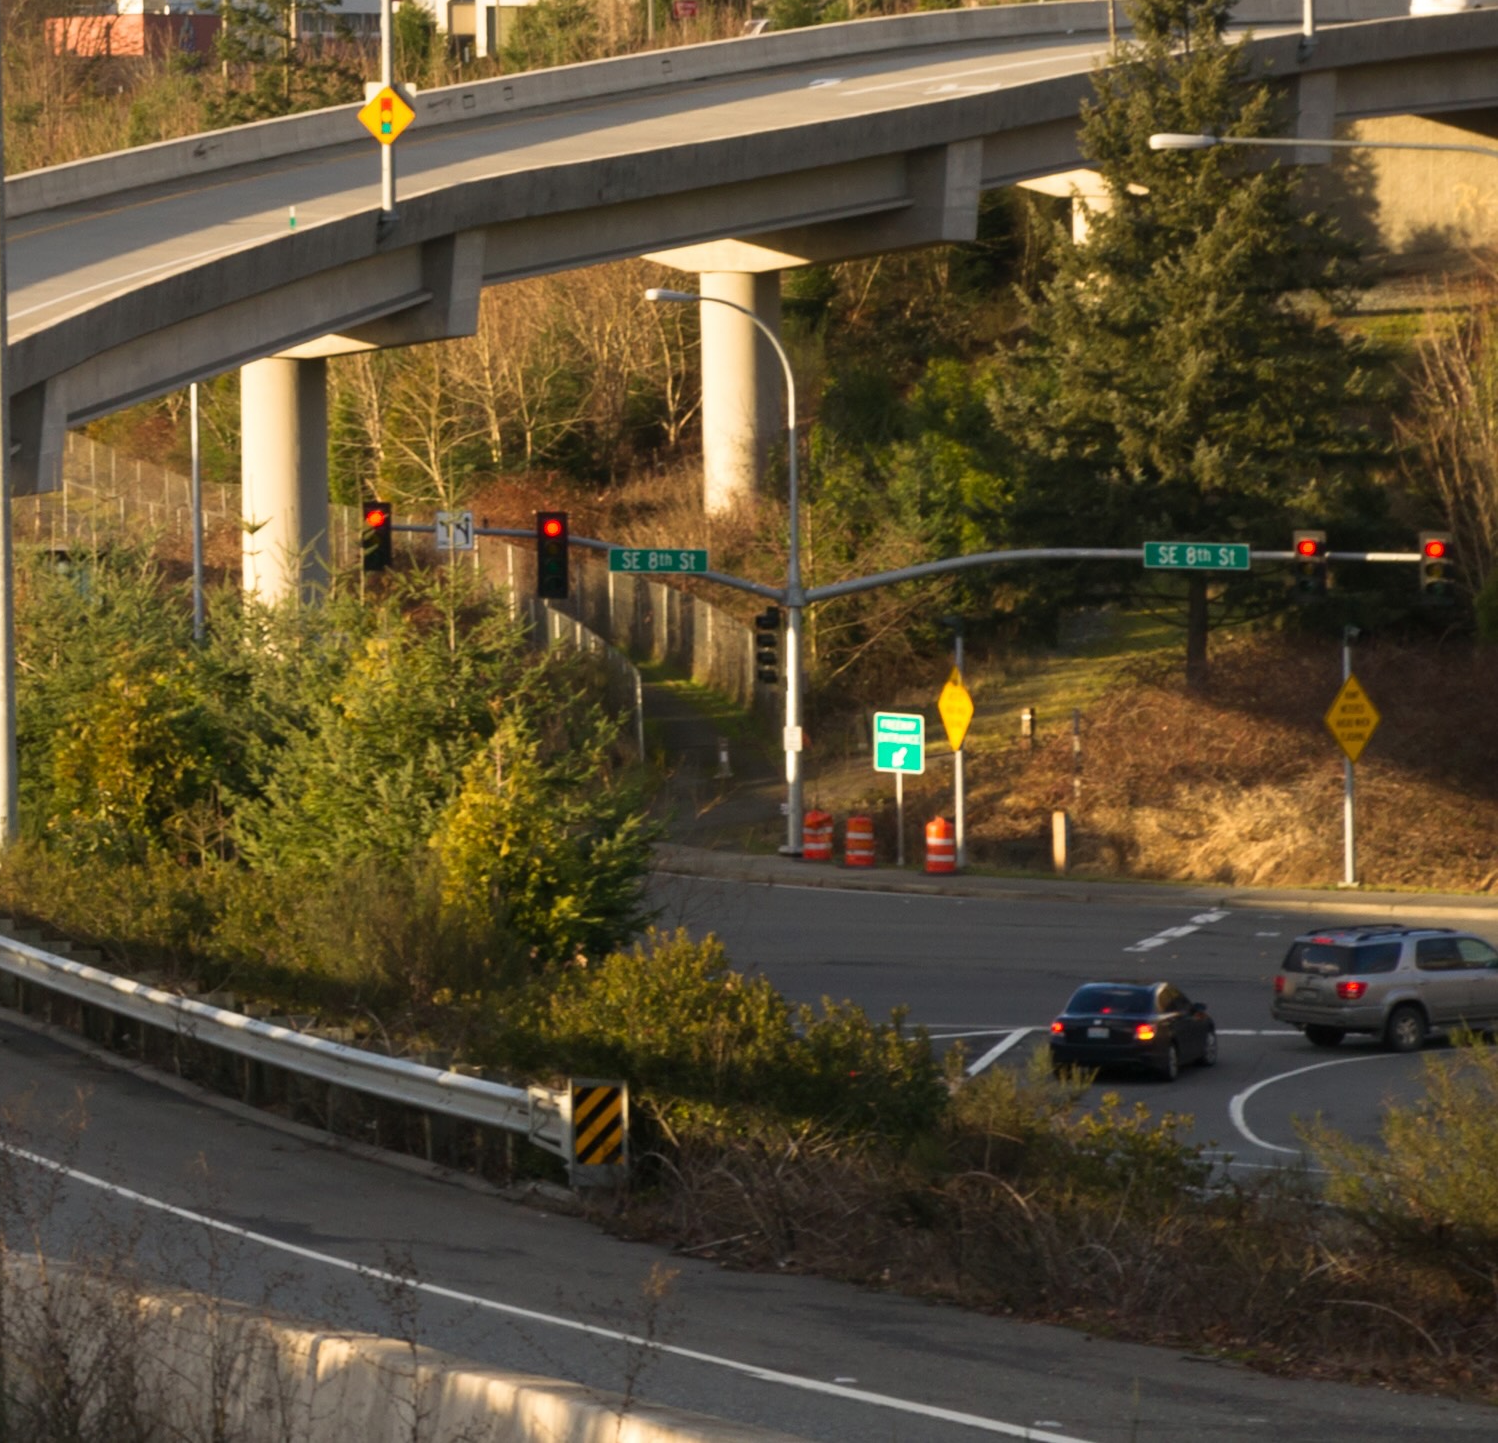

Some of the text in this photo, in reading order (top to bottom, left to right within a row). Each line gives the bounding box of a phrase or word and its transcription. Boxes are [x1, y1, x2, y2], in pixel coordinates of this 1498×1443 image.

[622, 551, 696, 570] SE 8th St
[1158, 546, 1236, 566] SE 8th St
